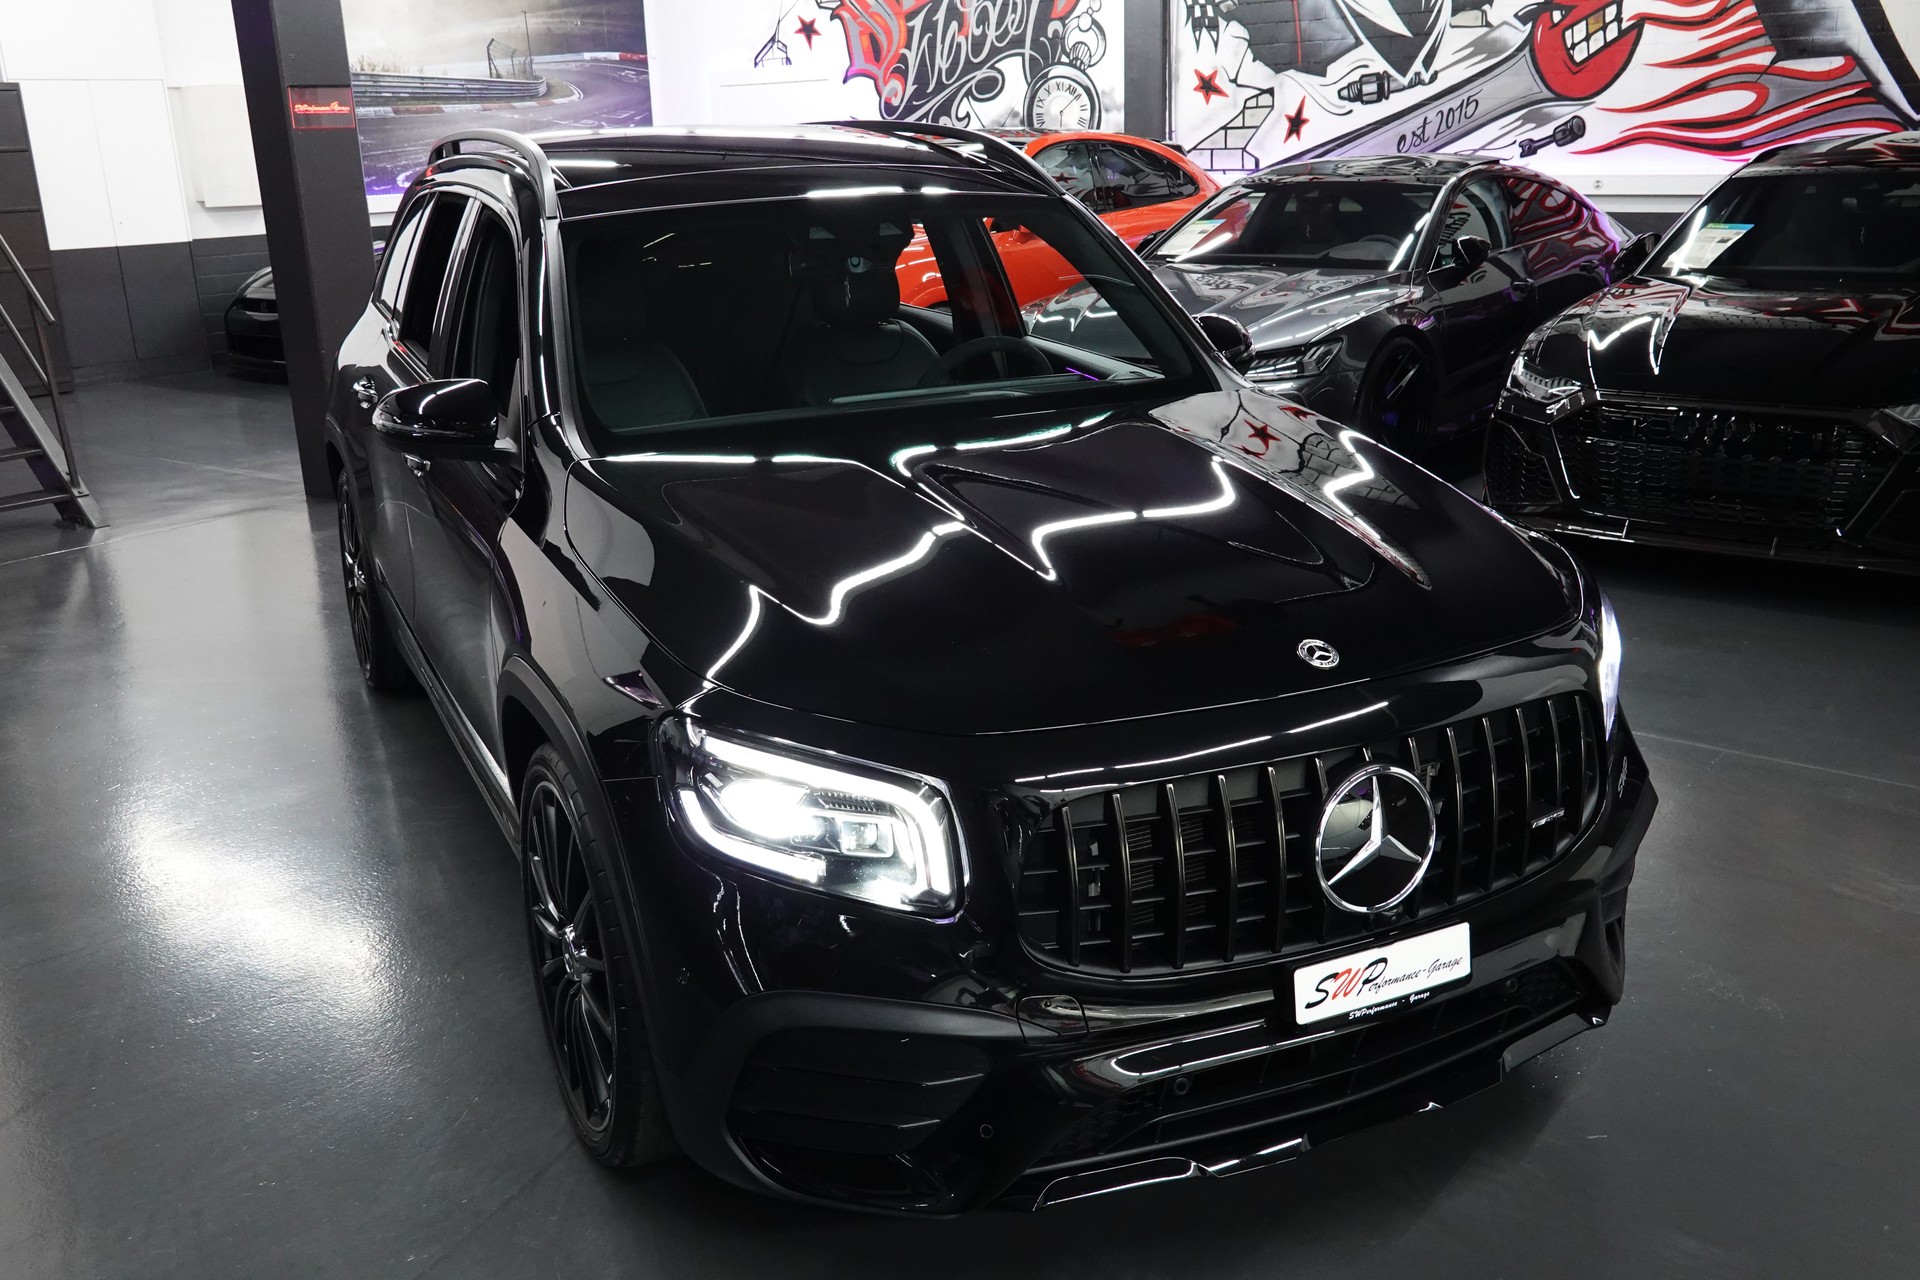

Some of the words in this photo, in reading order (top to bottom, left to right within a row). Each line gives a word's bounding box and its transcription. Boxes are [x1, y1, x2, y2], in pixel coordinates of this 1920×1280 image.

[1397, 115, 1432, 153] est
[1434, 88, 1483, 139] 2015
[1409, 990, 1430, 1004] Garage
